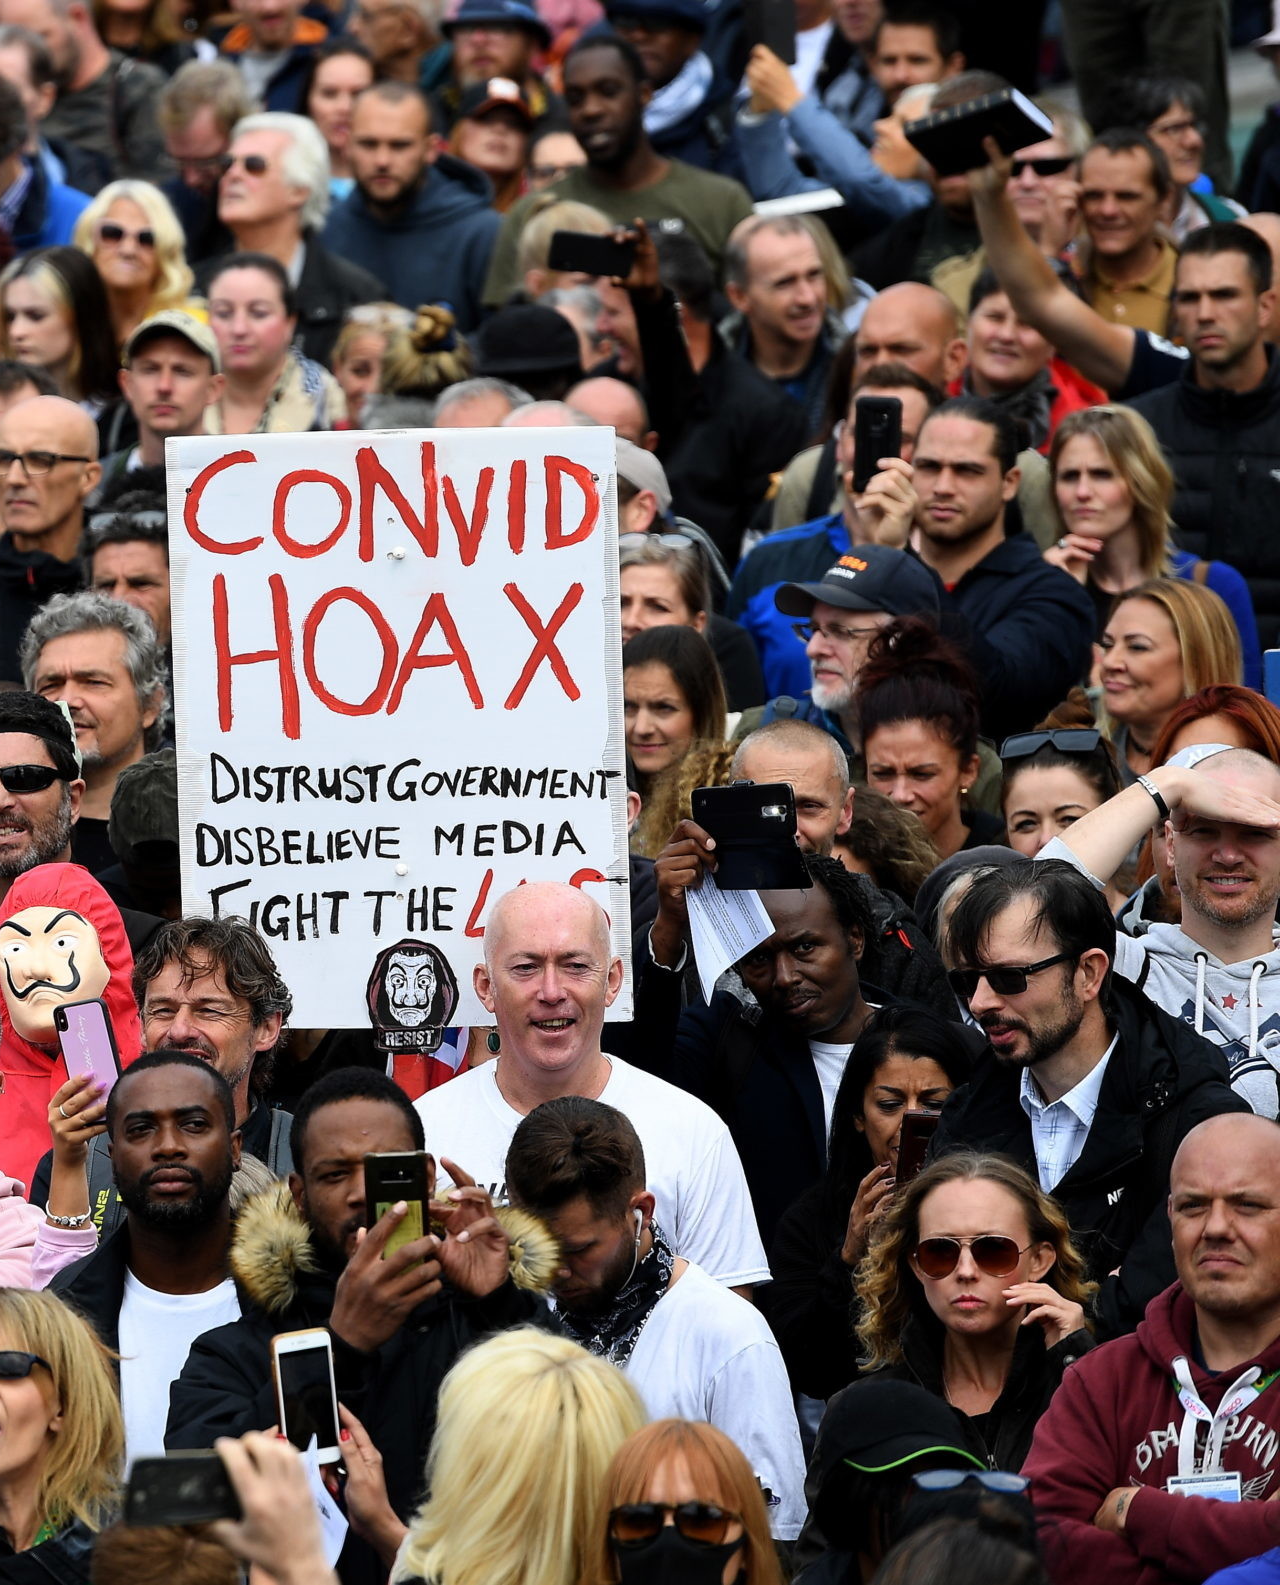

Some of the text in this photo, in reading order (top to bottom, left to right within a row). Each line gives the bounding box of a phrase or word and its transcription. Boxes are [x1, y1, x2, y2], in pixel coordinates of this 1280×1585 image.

[183, 441, 600, 567] CONVID
[212, 573, 584, 740] HOAX
[210, 752, 622, 804] DISTRUST GOVERNMENT
[195, 820, 587, 867] DISBELIEVE MEDIA
[363, 885, 457, 937] THE
[384, 1029, 435, 1047] RESIST
[1221, 1396, 1243, 1418] TESCO
